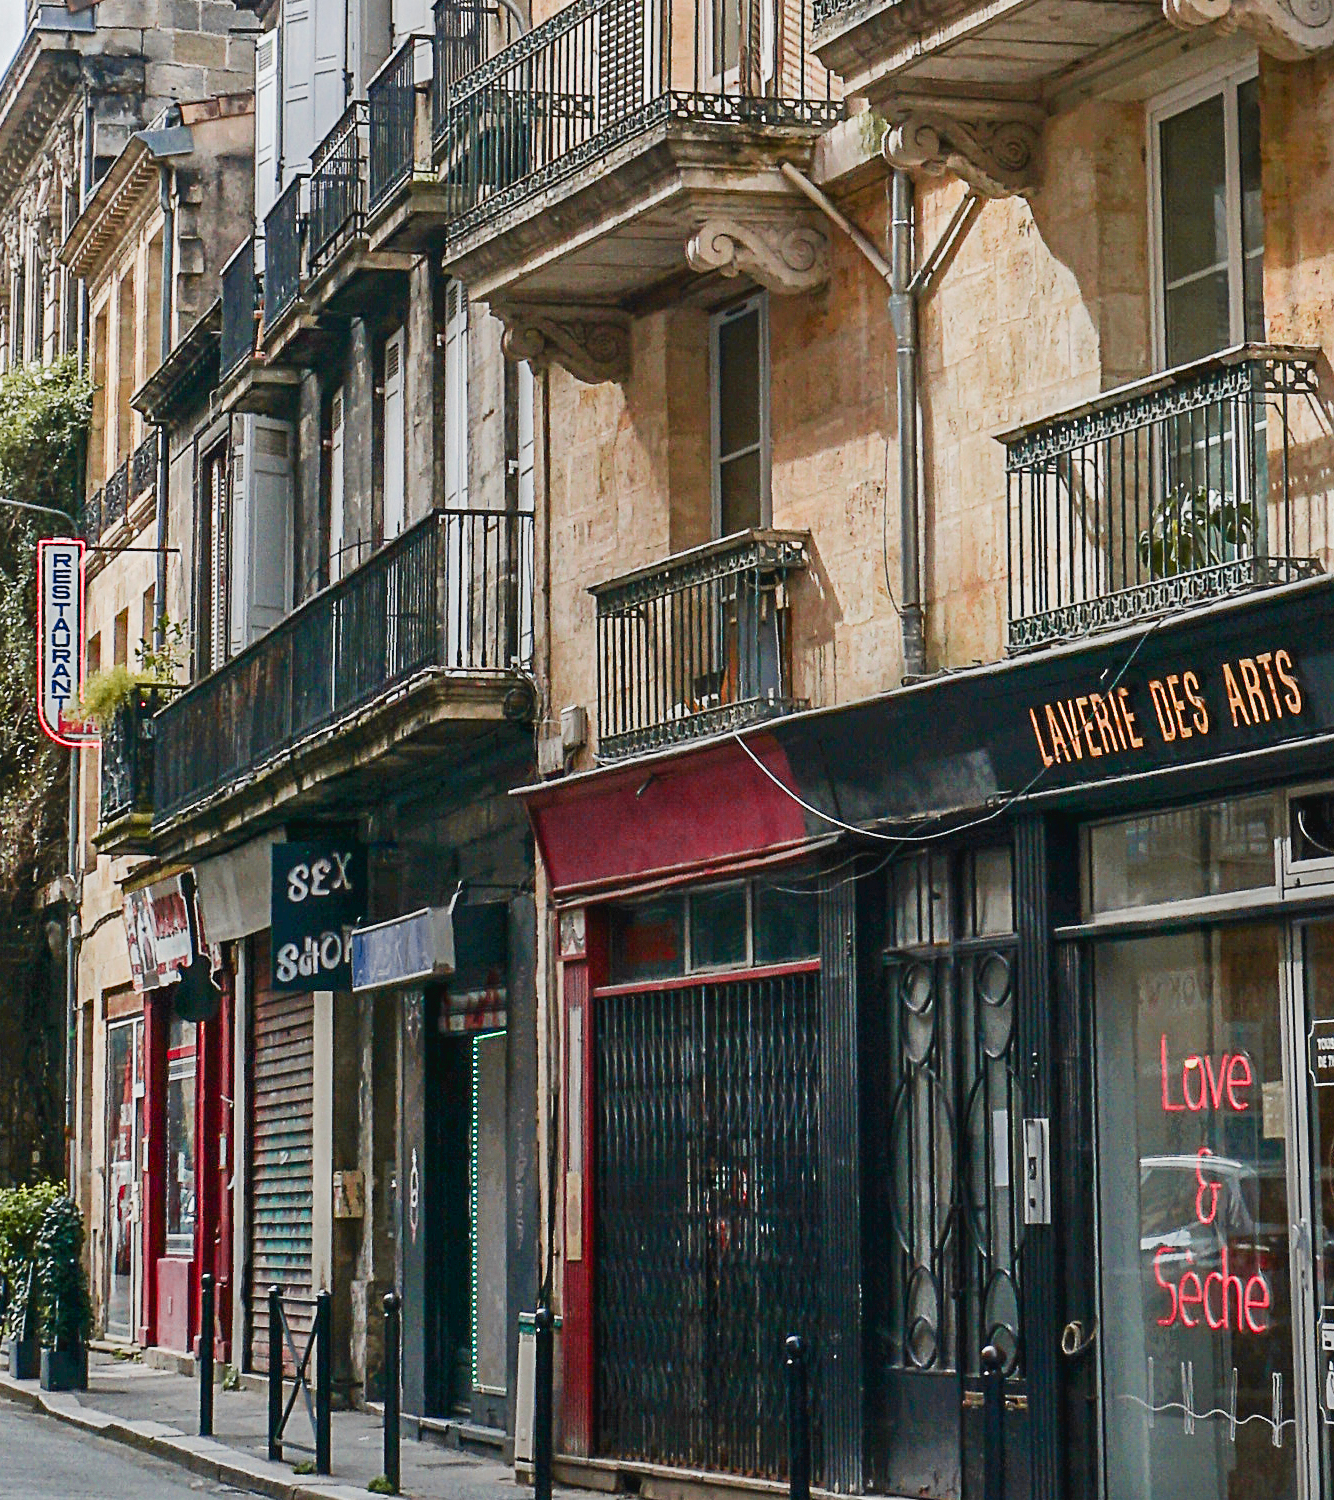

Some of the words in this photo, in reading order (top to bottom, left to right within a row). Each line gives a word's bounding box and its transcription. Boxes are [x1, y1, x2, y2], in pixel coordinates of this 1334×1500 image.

[51, 553, 72, 710] RESTAURANT
[1029, 686, 1144, 769] LAVERIE
[1148, 671, 1209, 742] DES
[1222, 649, 1303, 728] ARTS
[287, 852, 353, 903] SEX
